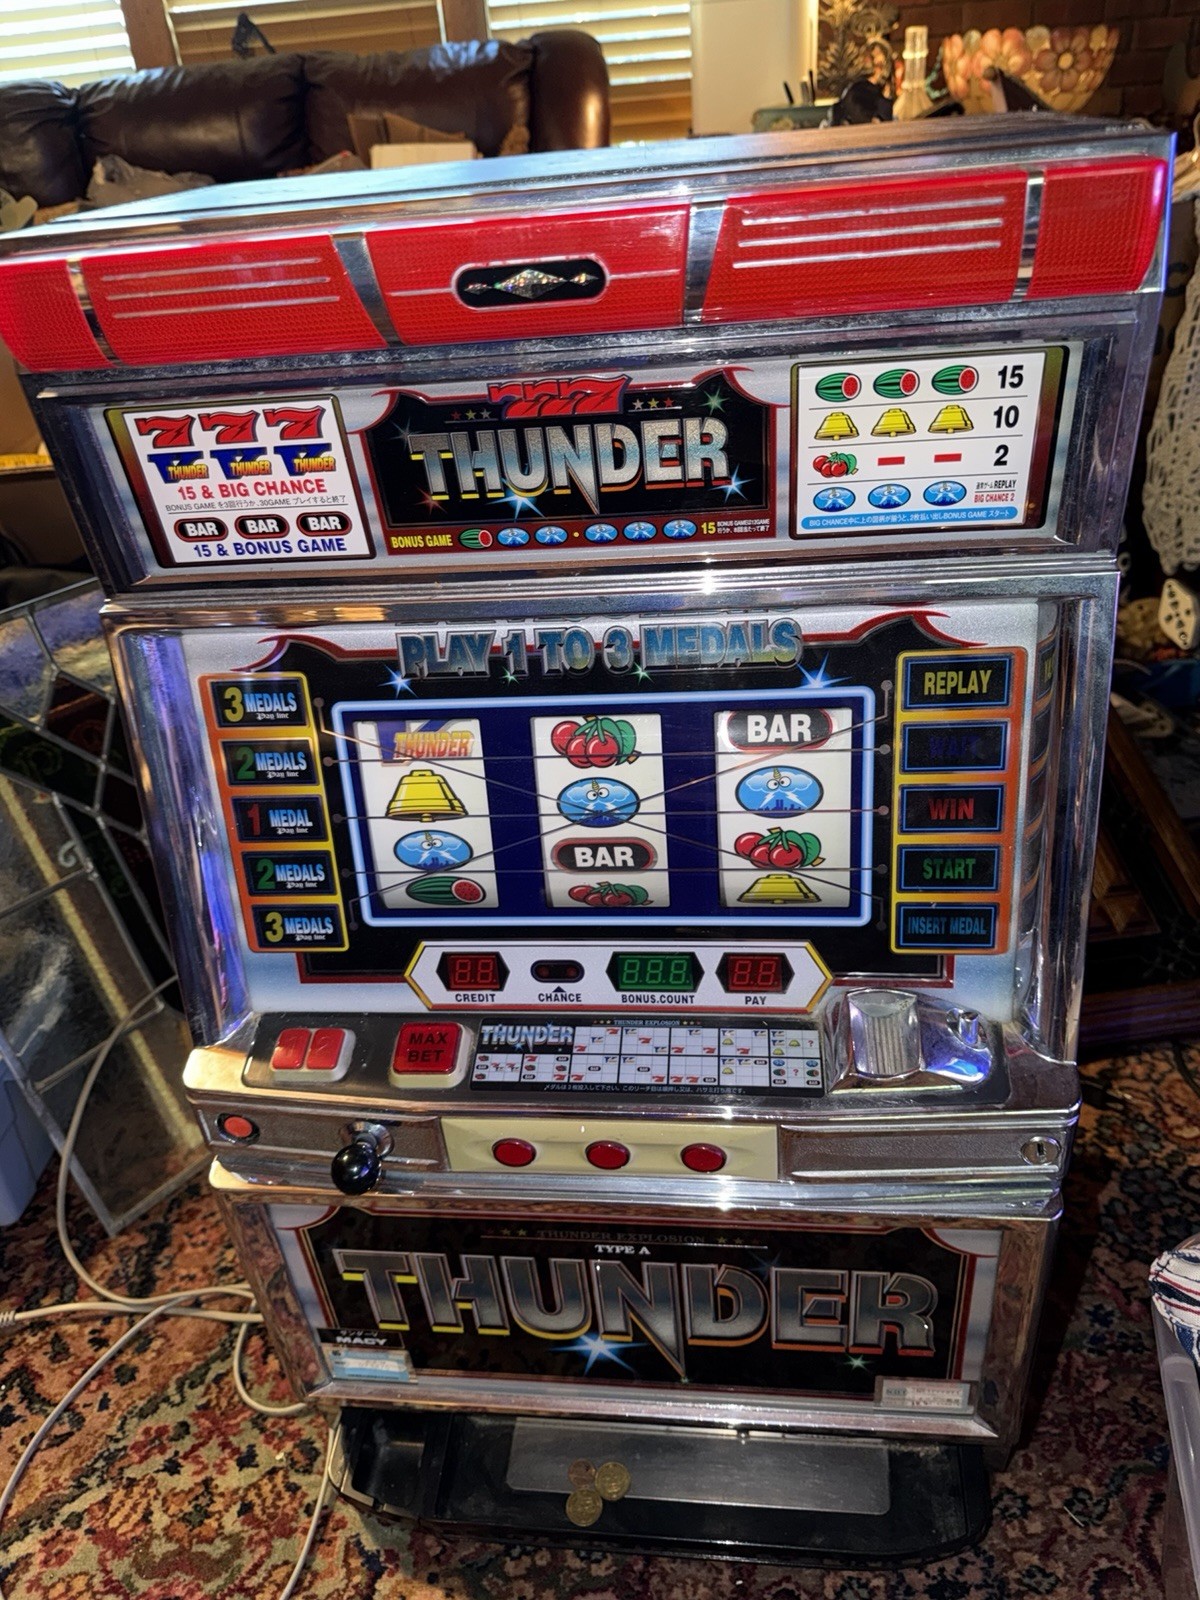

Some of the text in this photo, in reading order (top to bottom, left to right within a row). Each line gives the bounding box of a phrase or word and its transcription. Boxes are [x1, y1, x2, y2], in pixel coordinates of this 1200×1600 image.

[997, 364, 1024, 389] 15
[993, 405, 1019, 428] 10
[407, 417, 733, 516] THUNDER
[993, 445, 1009, 467] 2
[168, 456, 336, 481] THUNDER THUNDER THUNDER
[177, 478, 327, 501] 15 & BIG CHANCE
[993, 479, 1017, 489] REPLAY
[165, 503, 193, 512] BONUS
[193, 502, 215, 511] GAME
[974, 493, 1015, 503] BIG CHANCE 2
[184, 515, 341, 537] BAR BAR BAR
[701, 522, 717, 534] 15
[809, 519, 821, 527] BIG
[967, 510, 987, 519] GAME
[194, 537, 347, 558] 15 & BONUS GAME
[390, 533, 453, 549] BONUS GAME
[395, 617, 802, 680] PLAY 1 TO 3 MEDALS
[923, 669, 992, 696] REPLAY
[224, 686, 297, 722] 3 MEDALS
[746, 713, 812, 744] BAR
[236, 747, 307, 780] 2 MEDALS
[247, 803, 313, 836] 1 MEDAL
[928, 797, 974, 821] WIN
[573, 845, 635, 868] BAR
[256, 858, 325, 890] 2 MEDALS
[923, 858, 977, 880] START
[265, 911, 333, 942] 3 MEDALS
[908, 916, 987, 935] INSERT MEDAL
[455, 993, 496, 1003] CREDIT
[538, 993, 582, 1003] CHANCE
[745, 995, 767, 1005] PAY
[408, 1032, 448, 1045] MAX
[480, 1023, 575, 1052] THUNDER
[407, 1049, 445, 1063] BET
[537, 1229, 706, 1244] THUNDER EXPLOSION
[595, 1244, 651, 1255] TYPE A
[332, 1249, 940, 1380] THUNDER
[336, 1336, 387, 1346] MACY
